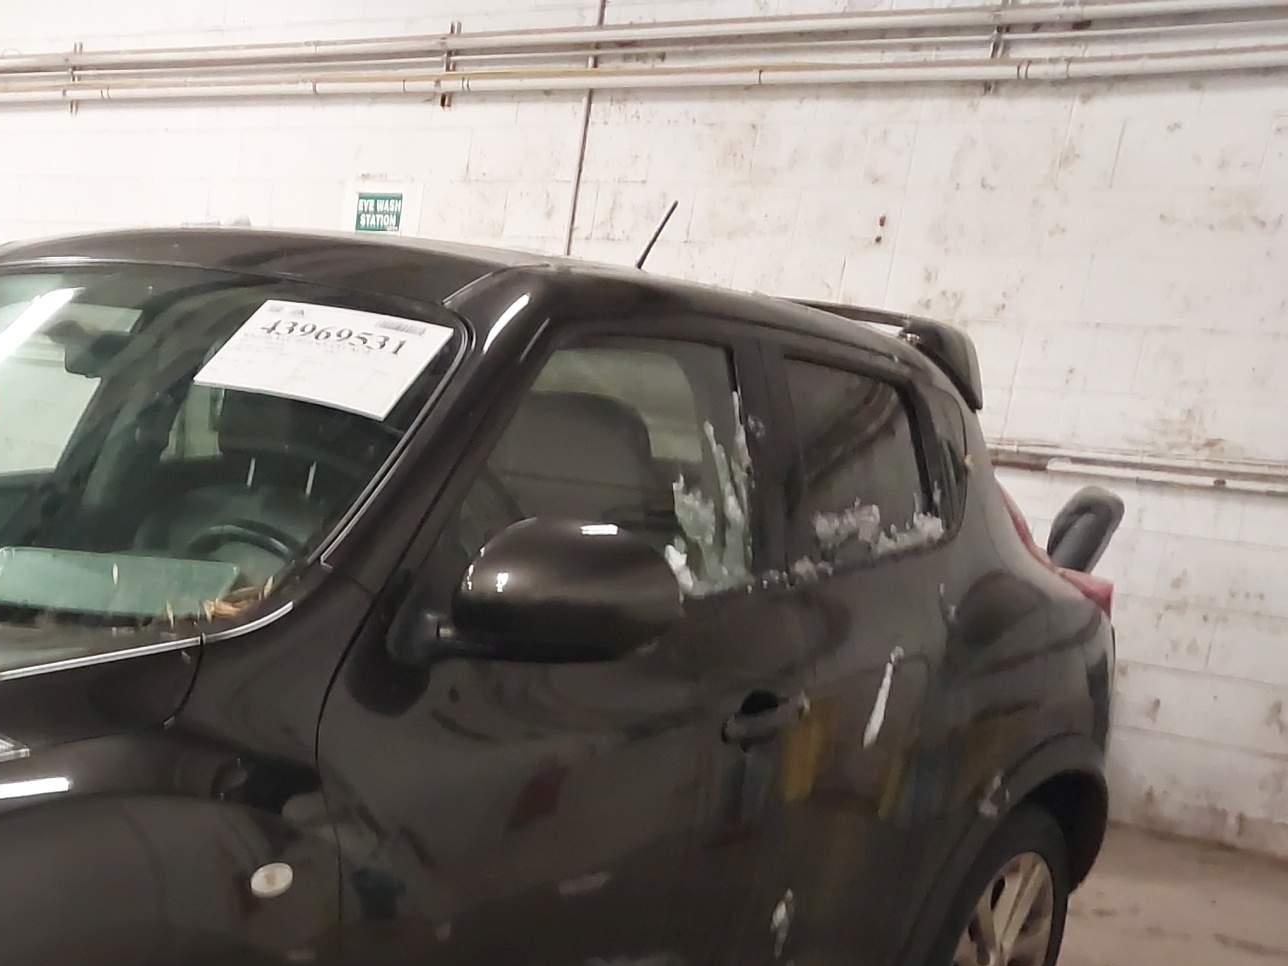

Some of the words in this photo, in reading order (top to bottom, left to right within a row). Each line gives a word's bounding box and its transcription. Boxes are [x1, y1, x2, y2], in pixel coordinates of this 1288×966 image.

[358, 199, 375, 212] EYE
[376, 199, 402, 213] WASH
[359, 213, 397, 227] STATION
[260, 319, 408, 356] 43969531
